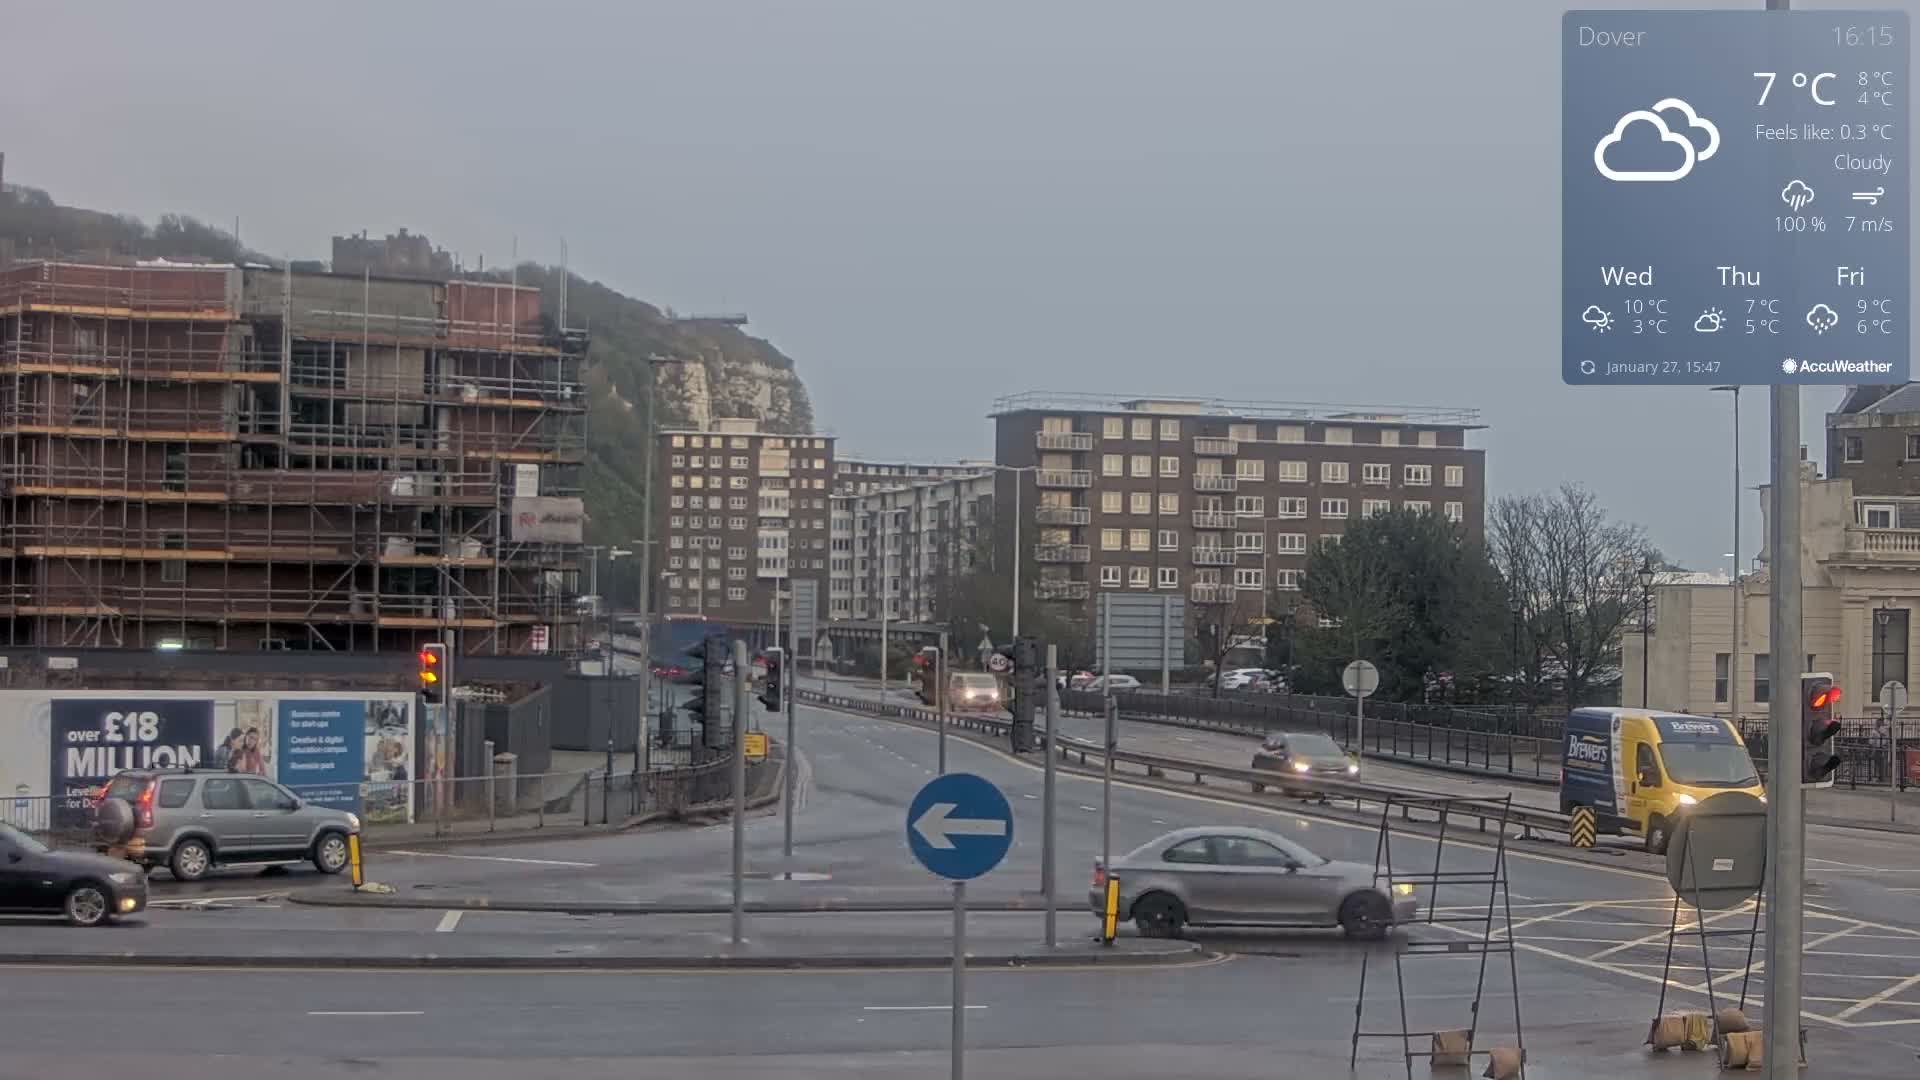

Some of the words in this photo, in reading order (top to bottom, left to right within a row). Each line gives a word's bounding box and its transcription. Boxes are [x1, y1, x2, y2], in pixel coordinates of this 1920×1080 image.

[67, 730, 100, 742] over
[105, 711, 159, 742] £18
[67, 745, 200, 777] MILLION
[1567, 734, 1608, 762] Brewers
[66, 798, 81, 809] for
